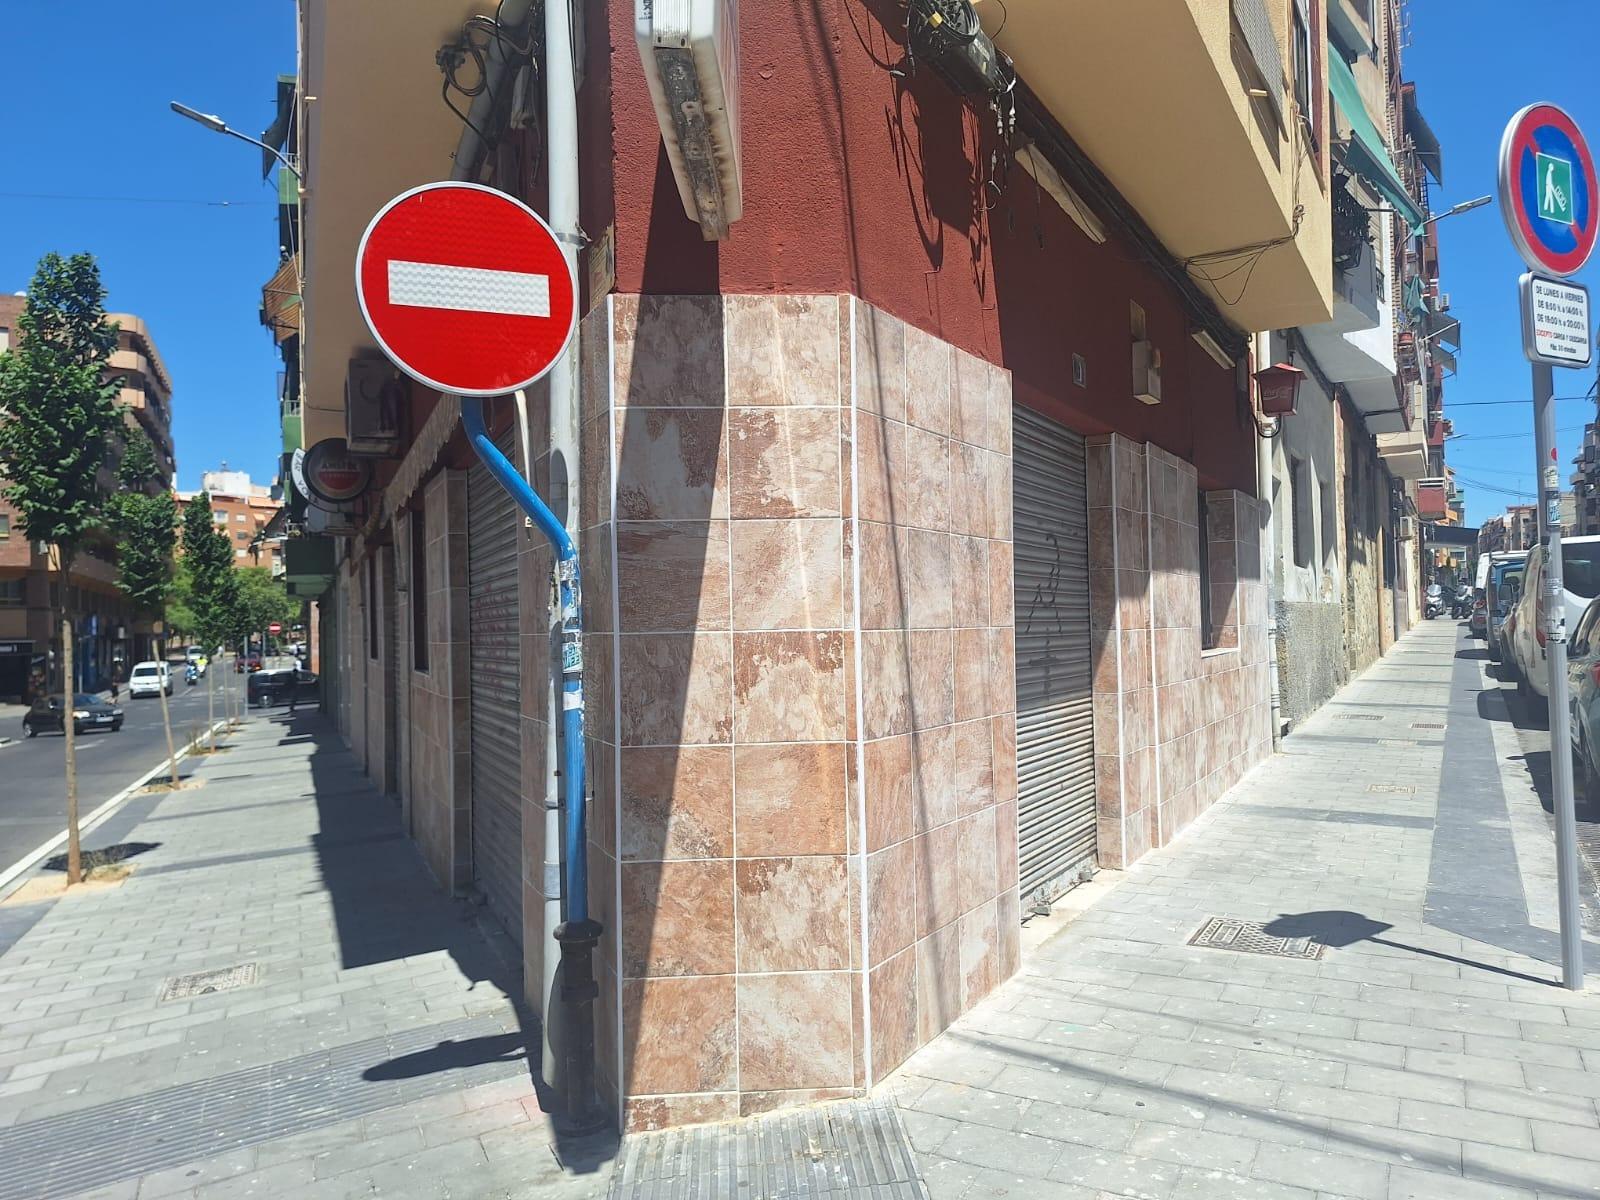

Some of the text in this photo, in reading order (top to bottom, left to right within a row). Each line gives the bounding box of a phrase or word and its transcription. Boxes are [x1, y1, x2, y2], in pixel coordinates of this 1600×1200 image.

[1536, 285, 1542, 294] DE
[1543, 287, 1559, 298] LUNES
[1565, 292, 1584, 303] VIERNES
[1538, 299, 1544, 308] DE
[1537, 313, 1544, 322] DE
[1536, 329, 1552, 338] EXCEPTO
[1553, 332, 1565, 340] CARGA
[1569, 335, 1587, 345] DESCARGA
